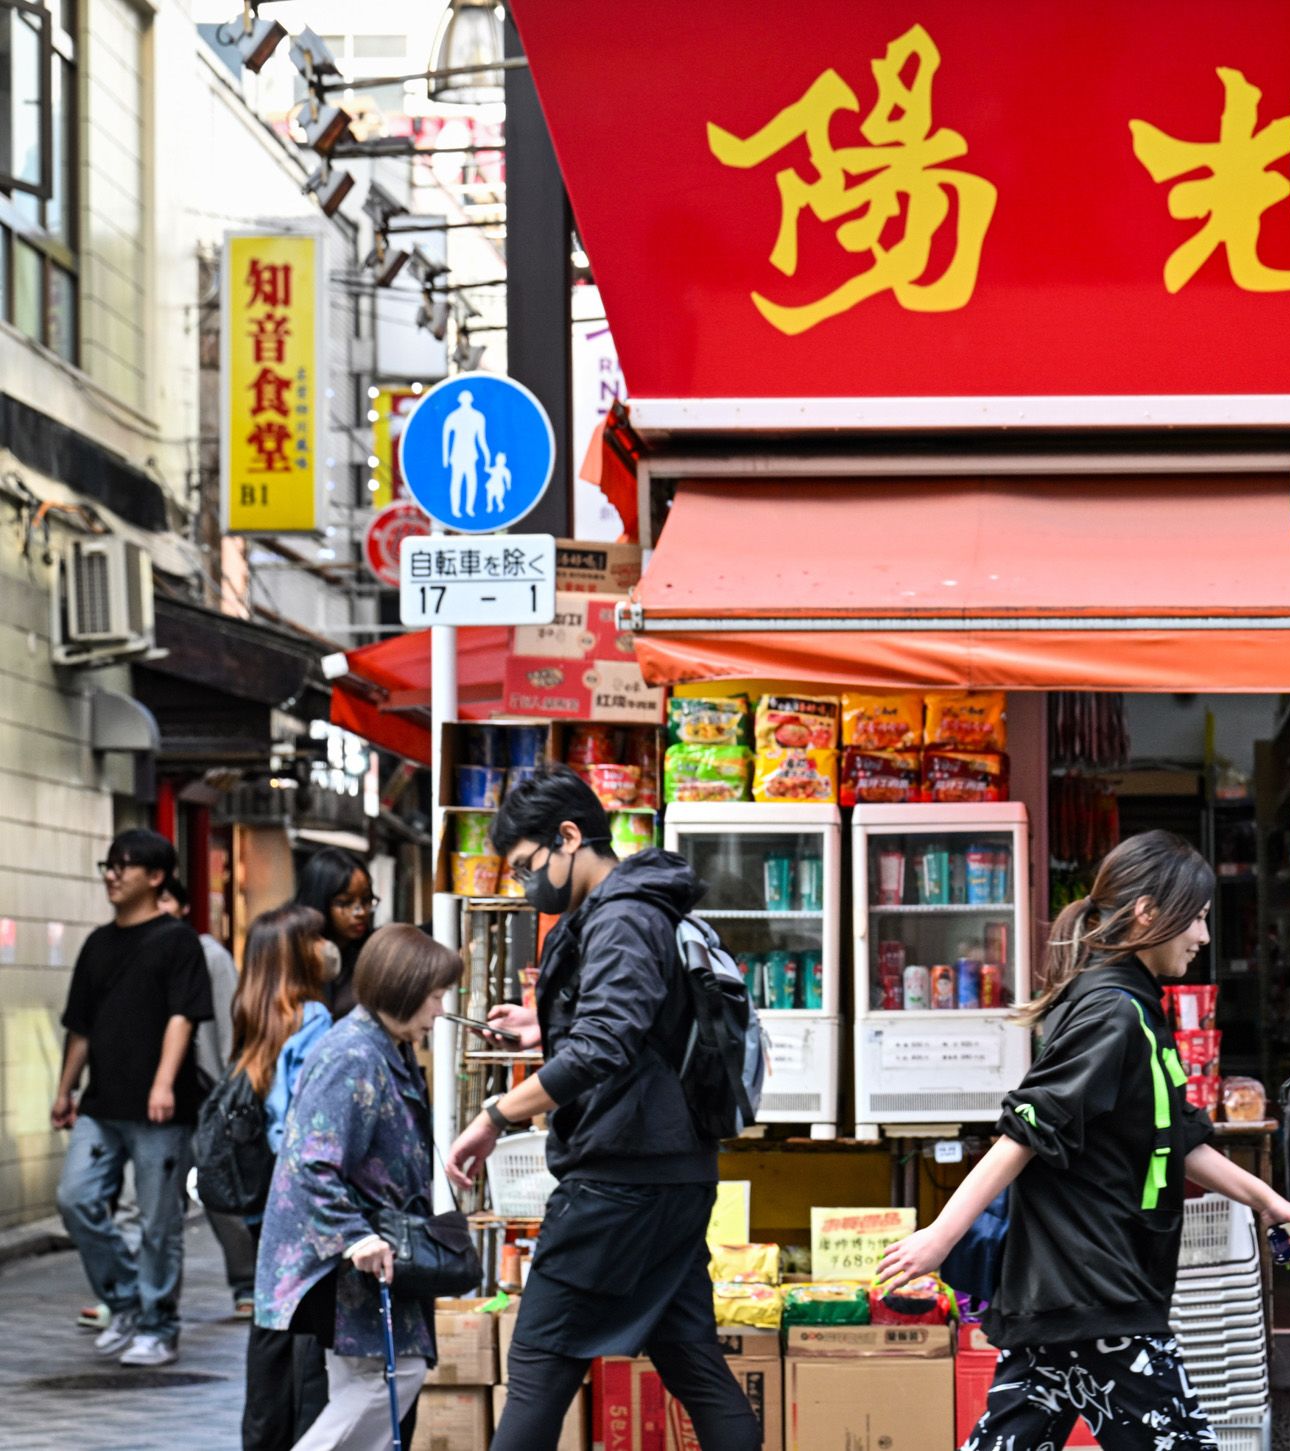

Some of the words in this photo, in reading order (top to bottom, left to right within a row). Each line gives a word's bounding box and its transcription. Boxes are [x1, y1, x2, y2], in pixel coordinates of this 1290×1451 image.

[246, 259, 292, 472] 知音食堂
[411, 548, 544, 577] 自転車を除く
[420, 586, 447, 614] 17
[530, 584, 537, 612] 1
